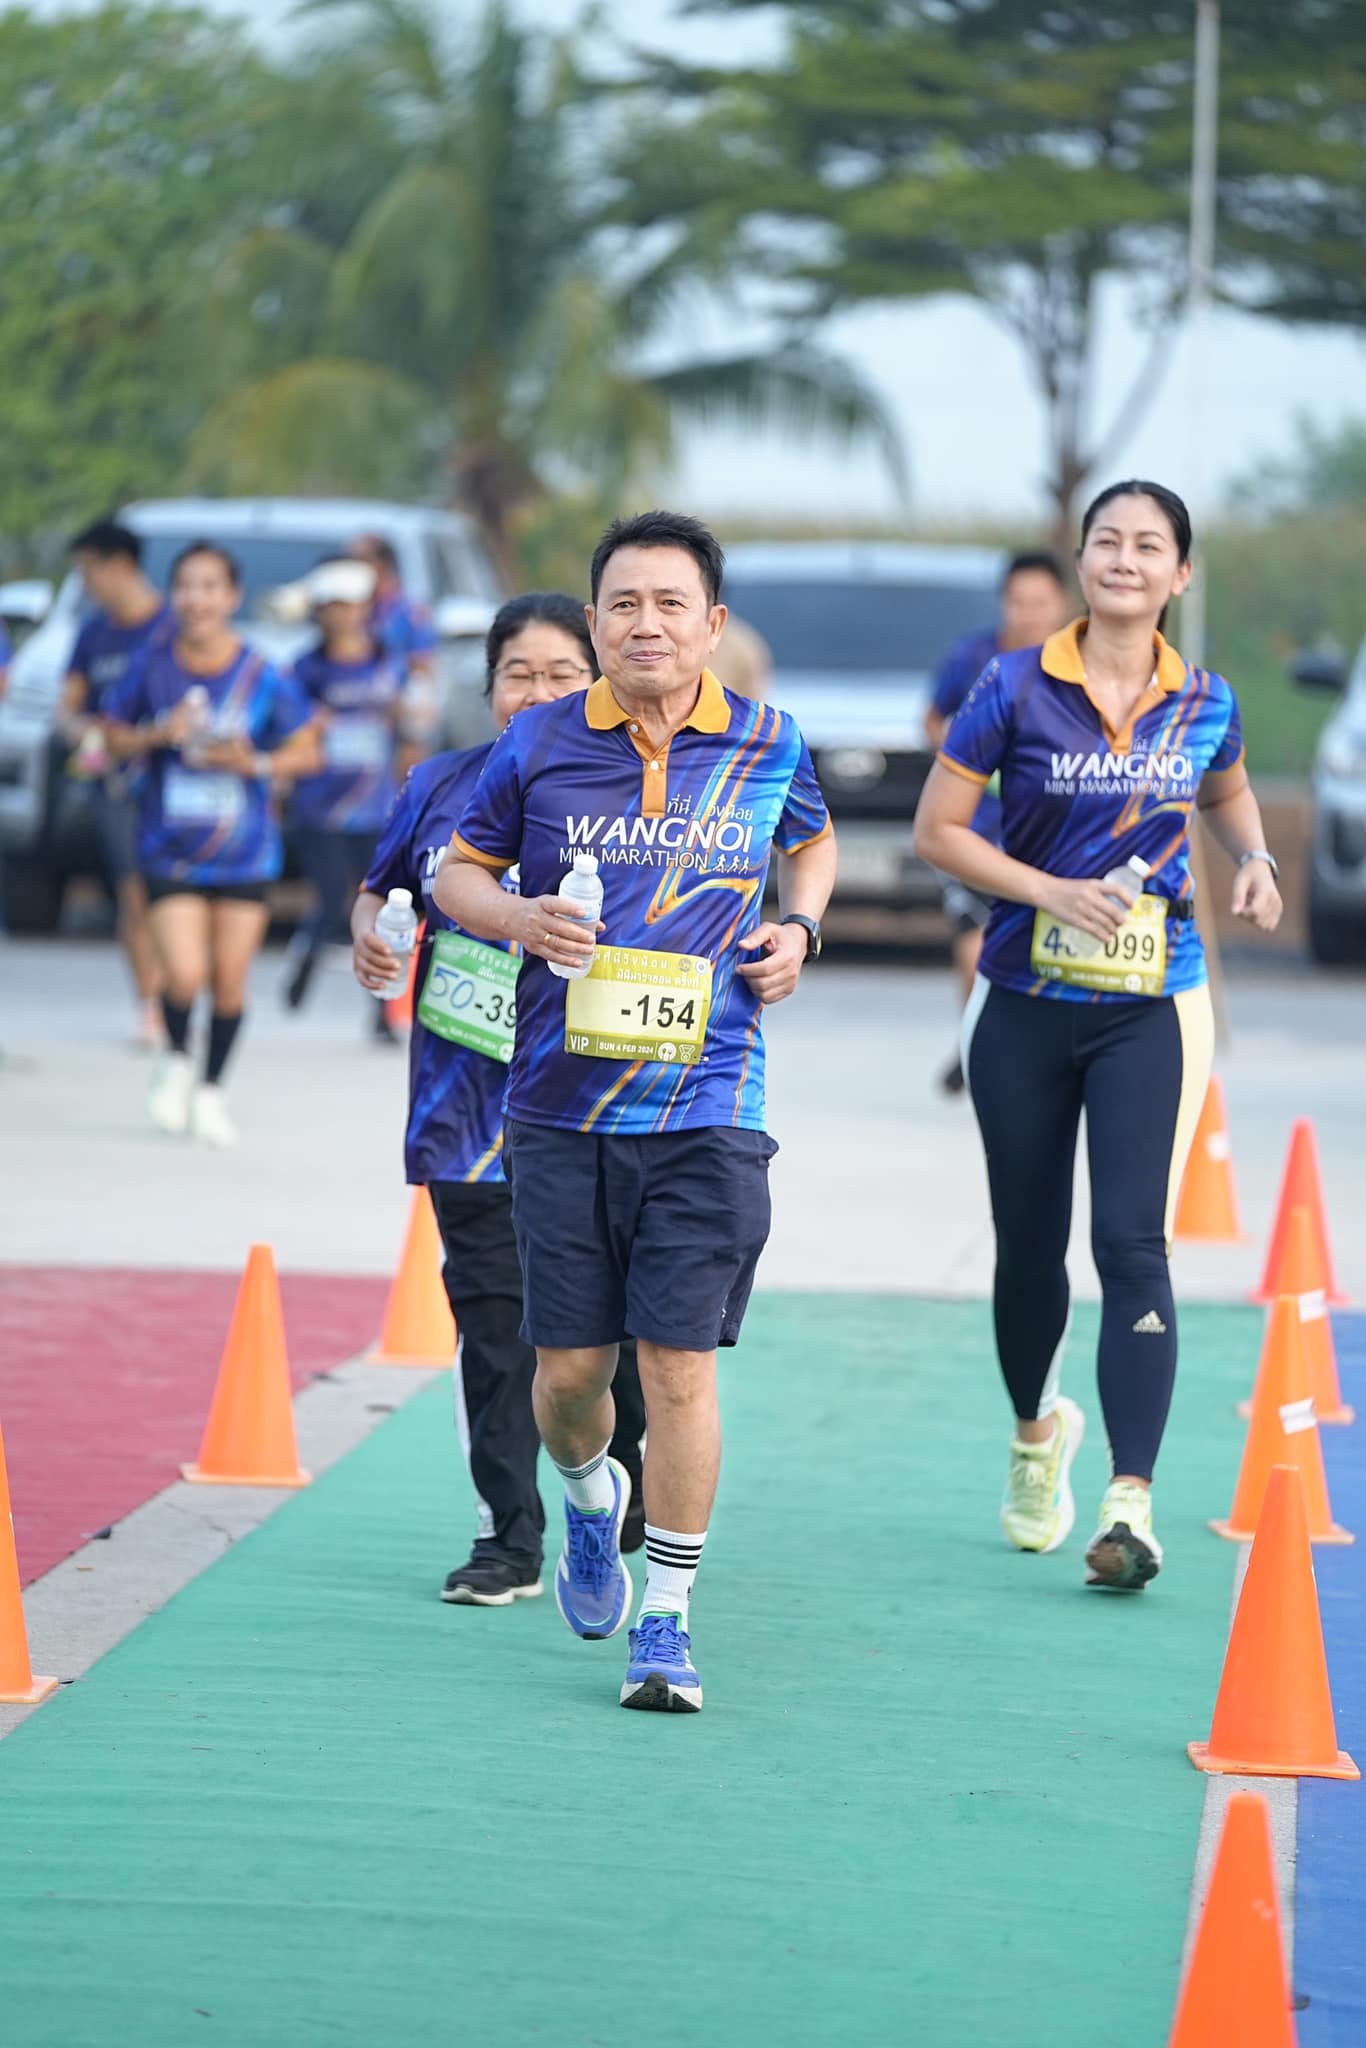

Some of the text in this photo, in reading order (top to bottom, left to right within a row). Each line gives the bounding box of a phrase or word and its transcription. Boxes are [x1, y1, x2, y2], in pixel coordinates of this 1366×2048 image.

[1051, 752, 1193, 781] WANGNOI
[1044, 779, 1165, 796] MINI MARATHON
[565, 815, 753, 853] WANGNOI
[602, 848, 708, 869] MARATHON
[621, 994, 695, 1030] -154
[570, 1034, 589, 1052] VIP
[599, 1041, 615, 1050] SUN
[622, 1043, 636, 1053] FEB
